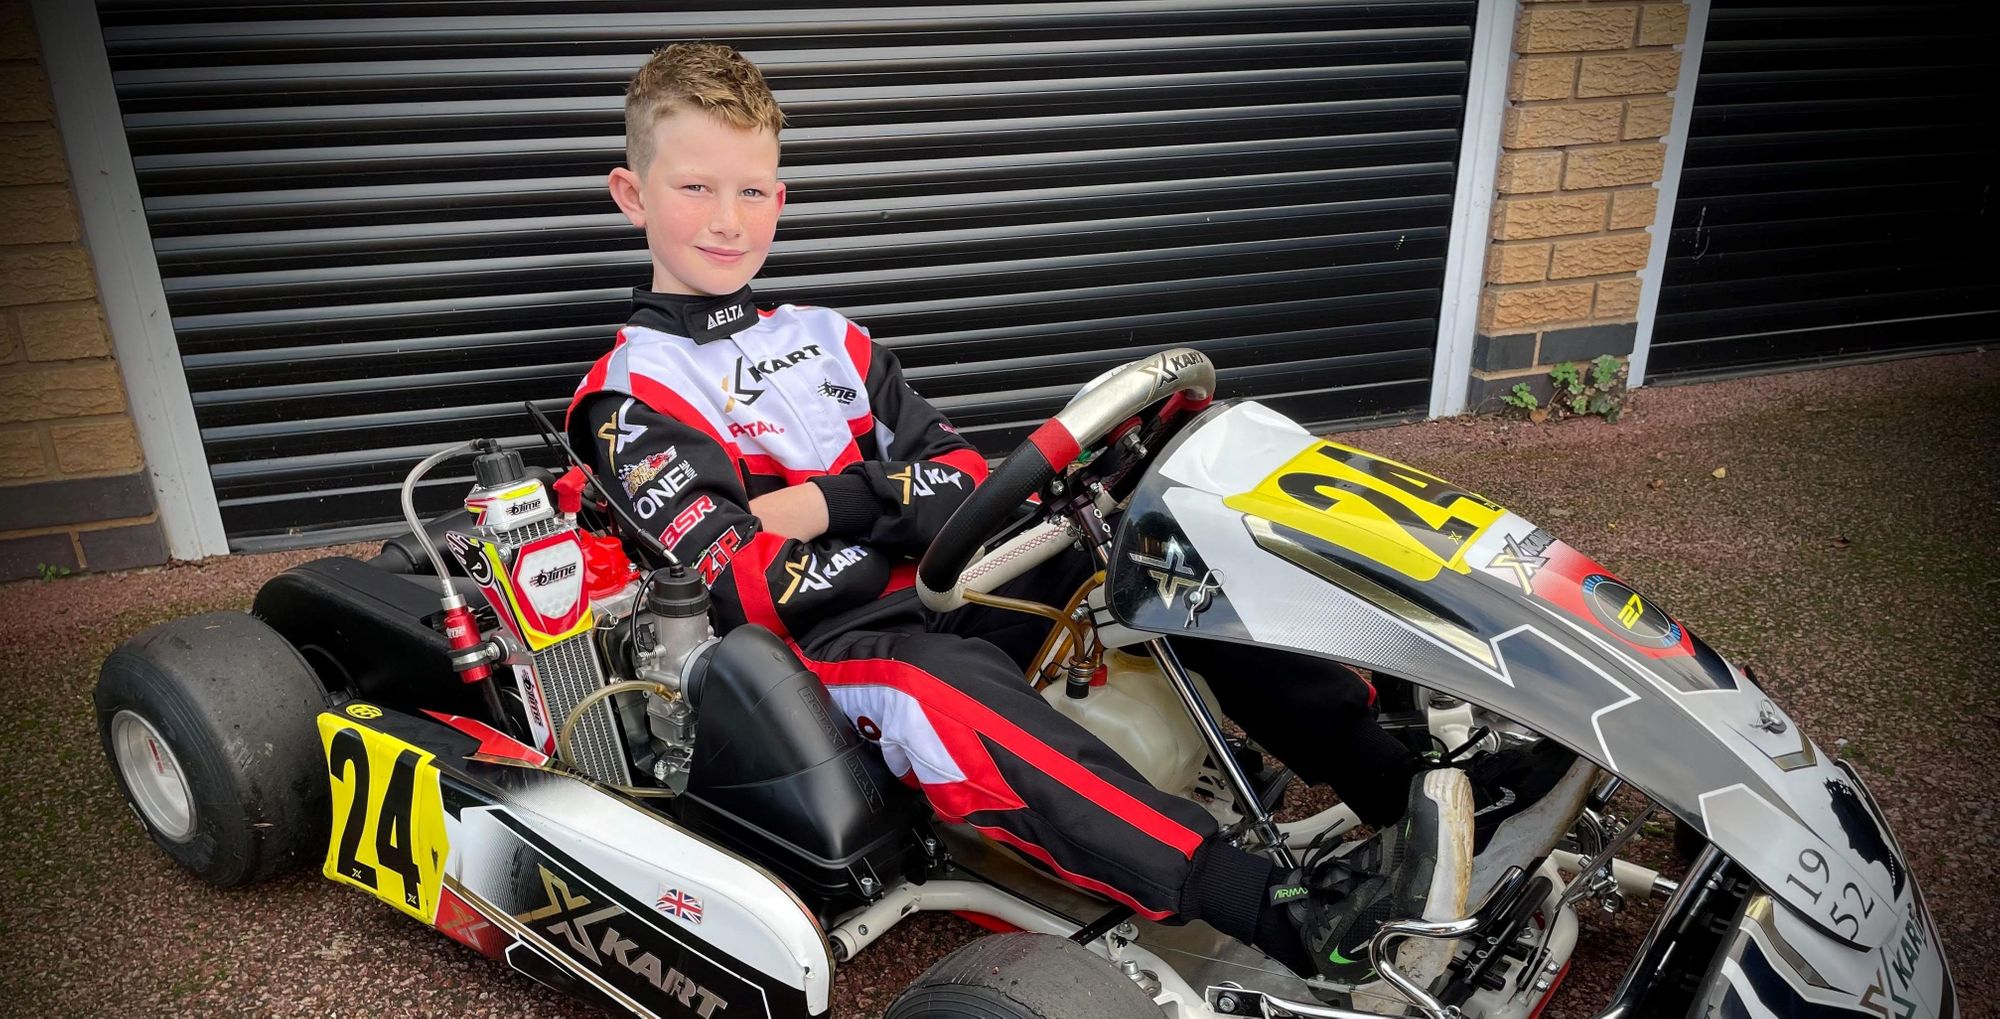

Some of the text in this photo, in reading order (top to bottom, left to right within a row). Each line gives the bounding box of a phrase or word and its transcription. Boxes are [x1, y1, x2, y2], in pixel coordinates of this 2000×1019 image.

[747, 344, 822, 383] KART
[637, 466, 690, 519] ONE
[1277, 445, 1503, 564] 24
[1617, 592, 1644, 630] 27
[329, 727, 421, 910] 24
[1786, 848, 1831, 904] 19
[1829, 881, 1875, 941] 52
[600, 926, 729, 1019] KART
